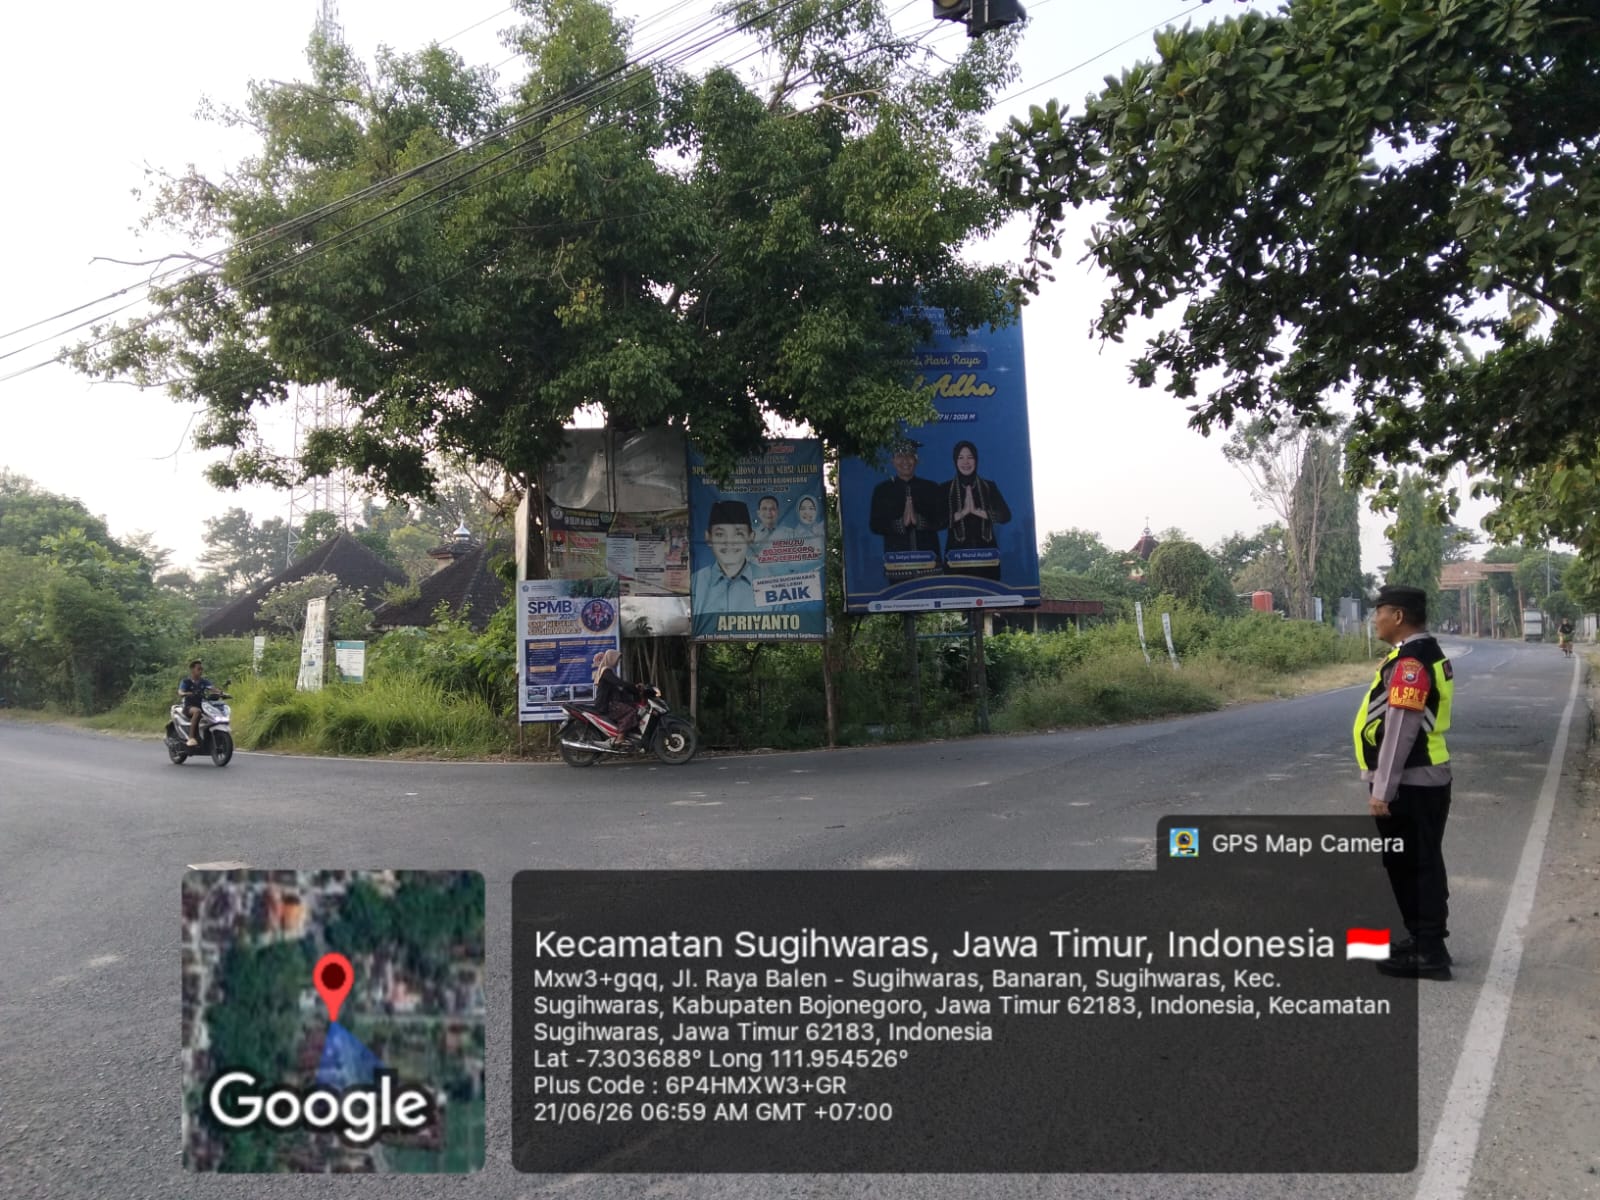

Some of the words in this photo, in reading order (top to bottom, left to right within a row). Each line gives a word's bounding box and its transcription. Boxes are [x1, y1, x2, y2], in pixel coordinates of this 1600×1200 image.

[952, 354, 981, 369] Raya
[765, 586, 812, 603] BAIK
[528, 600, 572, 615] SPMB
[717, 614, 800, 631] APRIYANTO
